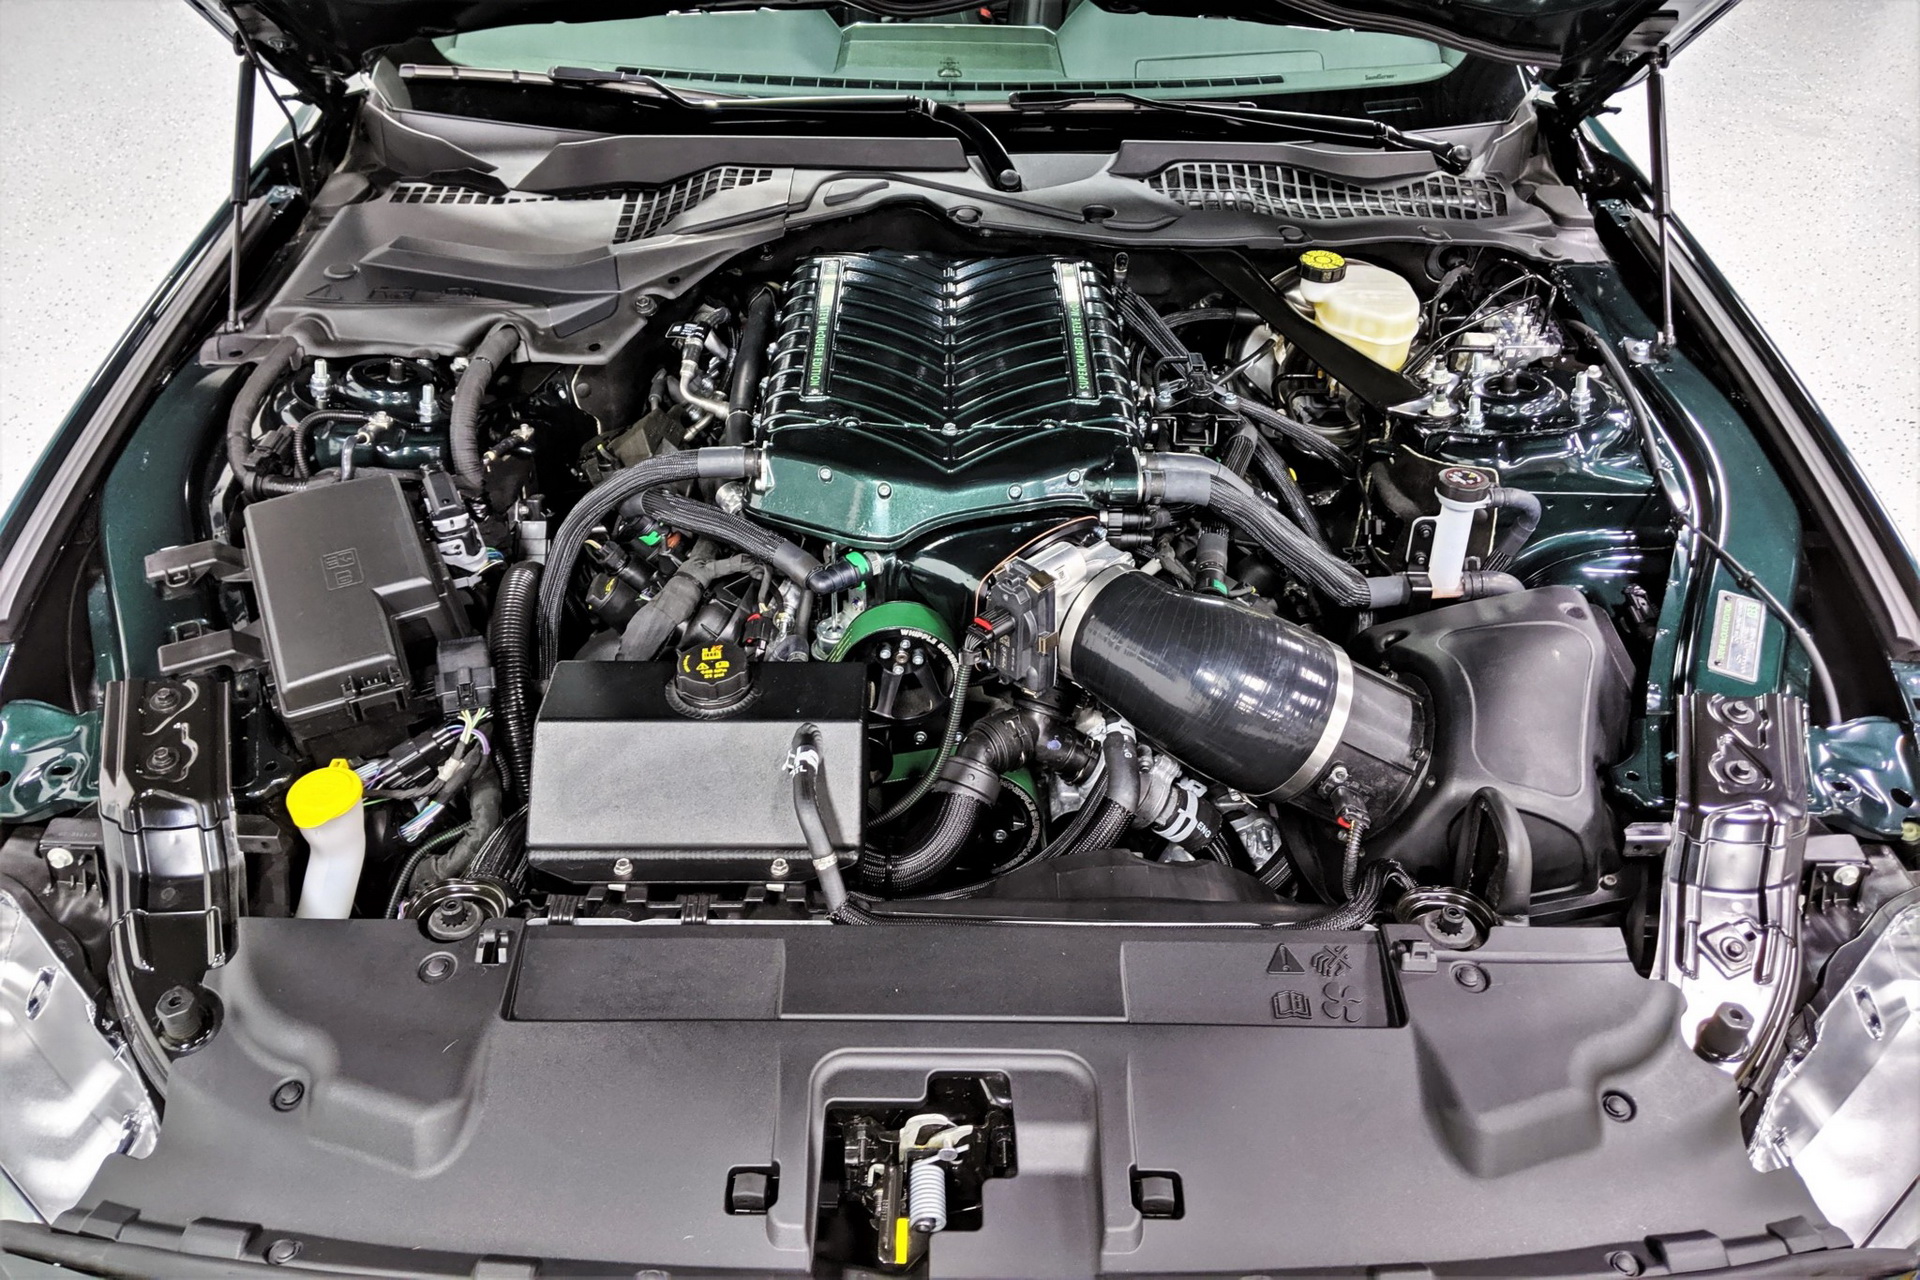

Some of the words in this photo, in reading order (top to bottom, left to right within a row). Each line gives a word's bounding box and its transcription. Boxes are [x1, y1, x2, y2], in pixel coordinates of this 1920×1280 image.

[818, 306, 830, 324] STEVE
[1071, 317, 1083, 336] STEVE
[810, 358, 823, 386] EDITION
[1073, 337, 1089, 390] SUPERCHARGED
[900, 629, 938, 645] WHIPPLE
[1196, 821, 1212, 838] ENG
